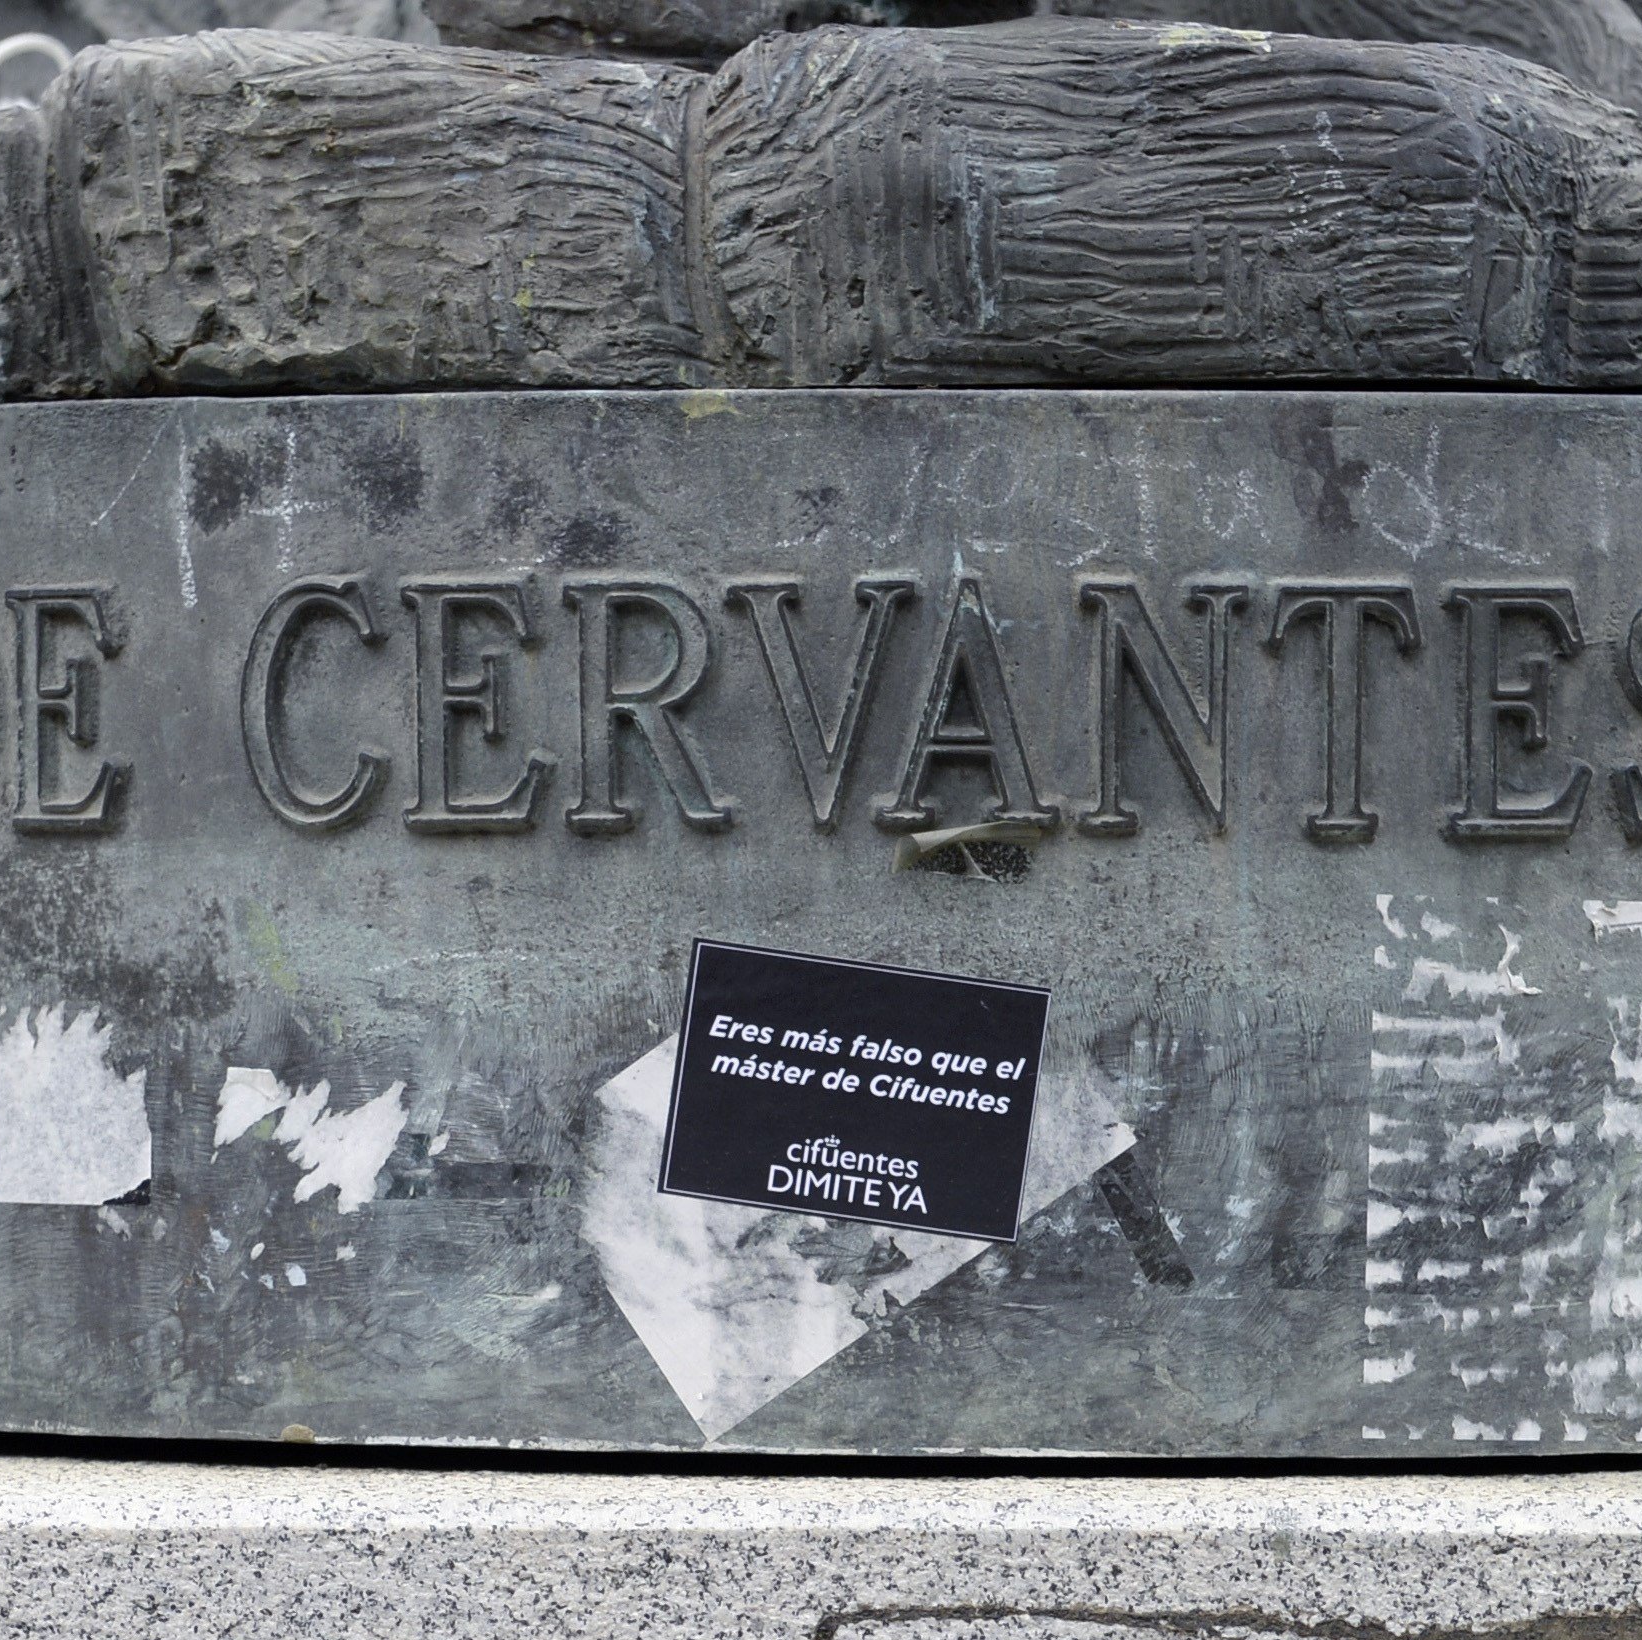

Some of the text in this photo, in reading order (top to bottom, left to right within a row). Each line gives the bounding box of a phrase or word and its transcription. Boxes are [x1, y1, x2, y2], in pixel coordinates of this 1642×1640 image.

[709, 1014, 1026, 1081] Eres más falso que el
[711, 1054, 1011, 1115] máster de Cifuentes
[787, 1137, 919, 1180] cifuentes
